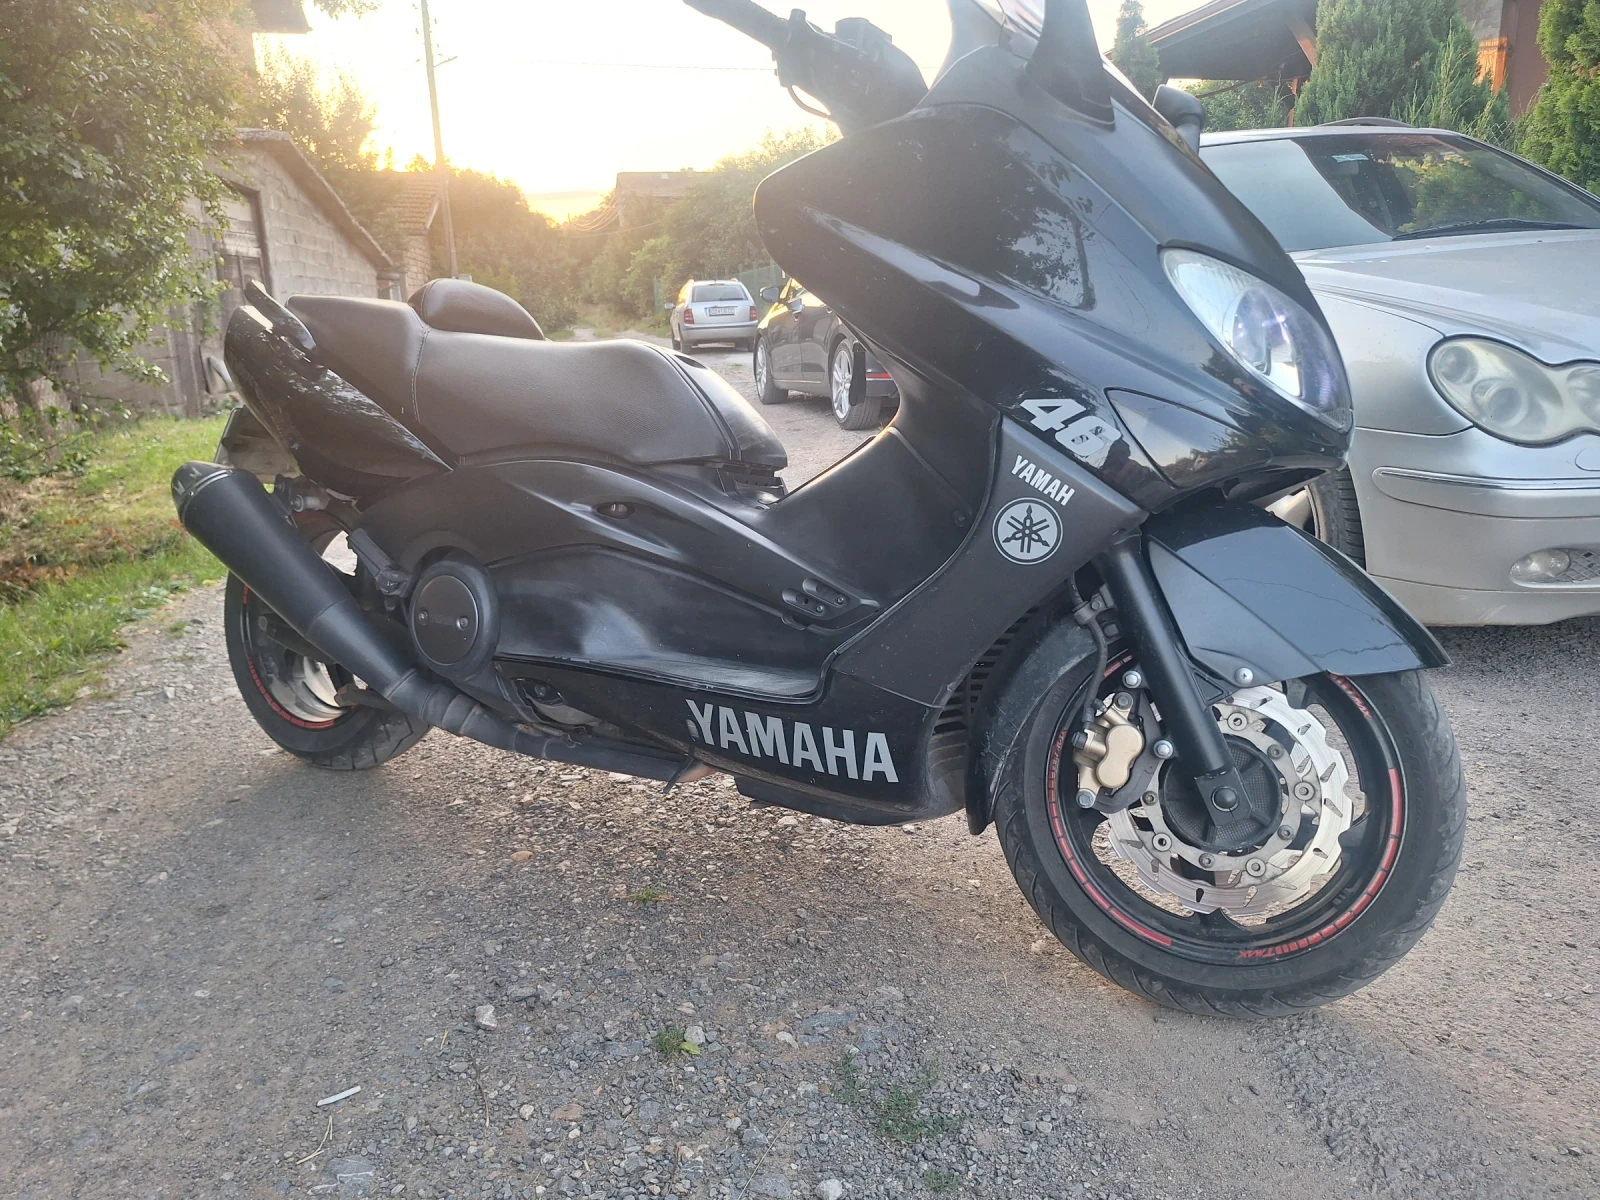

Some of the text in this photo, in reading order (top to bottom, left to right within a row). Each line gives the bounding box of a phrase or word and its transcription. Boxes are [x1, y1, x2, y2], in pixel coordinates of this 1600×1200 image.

[1020, 398, 1122, 457] 46
[1011, 455, 1075, 506] YAMAH
[685, 699, 899, 783] YAMAHA
